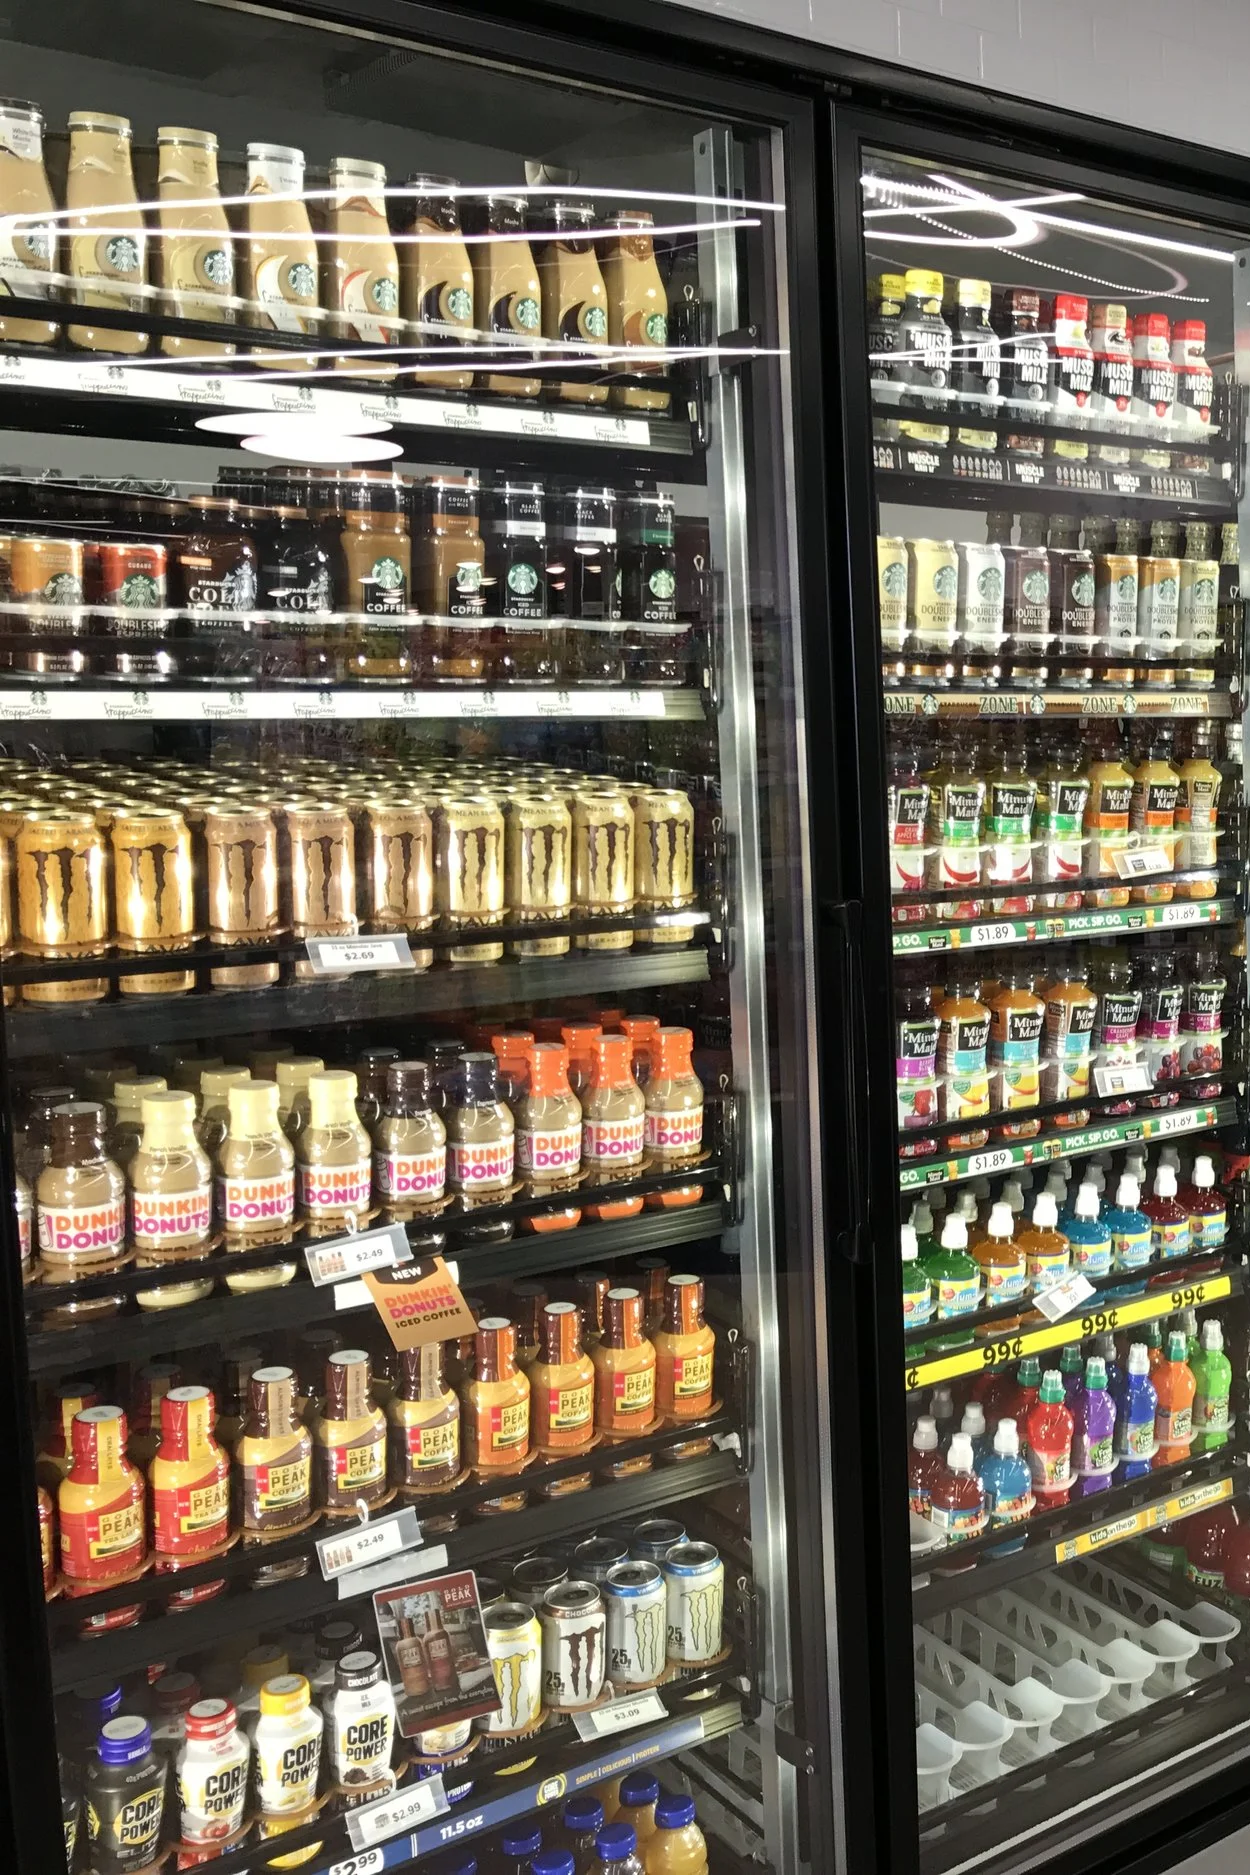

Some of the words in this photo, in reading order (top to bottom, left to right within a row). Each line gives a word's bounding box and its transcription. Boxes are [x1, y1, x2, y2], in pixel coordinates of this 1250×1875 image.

[908, 452, 940, 466] MUSCLE
[1016, 464, 1044, 476] MUSCLE
[1114, 475, 1140, 487] MUSCLE
[367, 603, 406, 614] COFFEE
[503, 607, 541, 617] COFFEE
[884, 696, 915, 713] ONE
[979, 697, 1017, 713] ZONE
[1083, 697, 1116, 712] ZONE
[1171, 697, 1206, 712] ZONE
[1003, 803, 1028, 815] Maid
[1109, 800, 1128, 810] Maid
[1156, 799, 1176, 809] Maid
[956, 806, 978, 818] Maid
[1068, 917, 1090, 929] PICK.
[1090, 915, 1105, 927] SIP.
[1106, 913, 1122, 925] GO.
[1168, 908, 1194, 920] $1.89
[902, 935, 921, 946] GO.
[977, 927, 1009, 940] $1.89
[345, 952, 374, 960] $2.69
[1198, 1001, 1220, 1011] Maid
[1112, 1013, 1135, 1023] Maid
[1019, 1027, 1040, 1037] Maid
[914, 1042, 936, 1053] Maid
[1166, 1117, 1191, 1129] $1.89
[1066, 1136, 1088, 1148] PICK.
[1089, 1133, 1102, 1145] SIP.
[1102, 1130, 1119, 1141] GO.
[975, 1154, 1006, 1169] $1.89
[900, 1171, 919, 1181] GO.
[356, 1248, 383, 1261] $2.49
[392, 1266, 421, 1280] NEW
[1172, 1287, 1205, 1309] 99¢
[390, 1296, 456, 1318] DONUTS
[396, 1314, 419, 1329] ICED
[422, 1307, 461, 1324] COFFEE
[1082, 1313, 1118, 1336] 99¢
[982, 1340, 1023, 1366] 99¢
[684, 1362, 710, 1377] PEAK
[627, 1377, 653, 1394] PEAK
[562, 1392, 591, 1410] PEAK
[422, 1428, 459, 1449] PEAK
[271, 1469, 307, 1489] PEAK
[193, 1489, 228, 1511] PEAK
[1179, 1495, 1196, 1508] kids
[1196, 1492, 1203, 1501] on
[1204, 1488, 1213, 1497] the
[1213, 1484, 1221, 1495] go
[102, 1512, 140, 1533] PEAK
[1090, 1529, 1108, 1543] kids
[1108, 1526, 1116, 1536] on
[1117, 1522, 1127, 1532] the
[1127, 1518, 1137, 1529] go
[357, 1534, 384, 1549] $2.49
[444, 1589, 472, 1603] PEAK
[348, 1672, 378, 1686] CHOCOLATE
[445, 1696, 458, 1706] from
[615, 1709, 639, 1720] $3.09
[347, 1719, 388, 1745] CORE
[283, 1735, 321, 1769] CORE
[347, 1740, 386, 1761] POWER
[576, 1770, 597, 1785] SIMPLE
[602, 1758, 632, 1775] DELICIOUS
[635, 1746, 660, 1760] PROTEIN
[205, 1765, 247, 1797] CORE
[544, 1780, 560, 1794] CORE
[122, 1795, 163, 1825] CORE
[392, 1803, 421, 1823] $2.99
[439, 1823, 464, 1840] 11.5
[466, 1815, 483, 1830] oz
